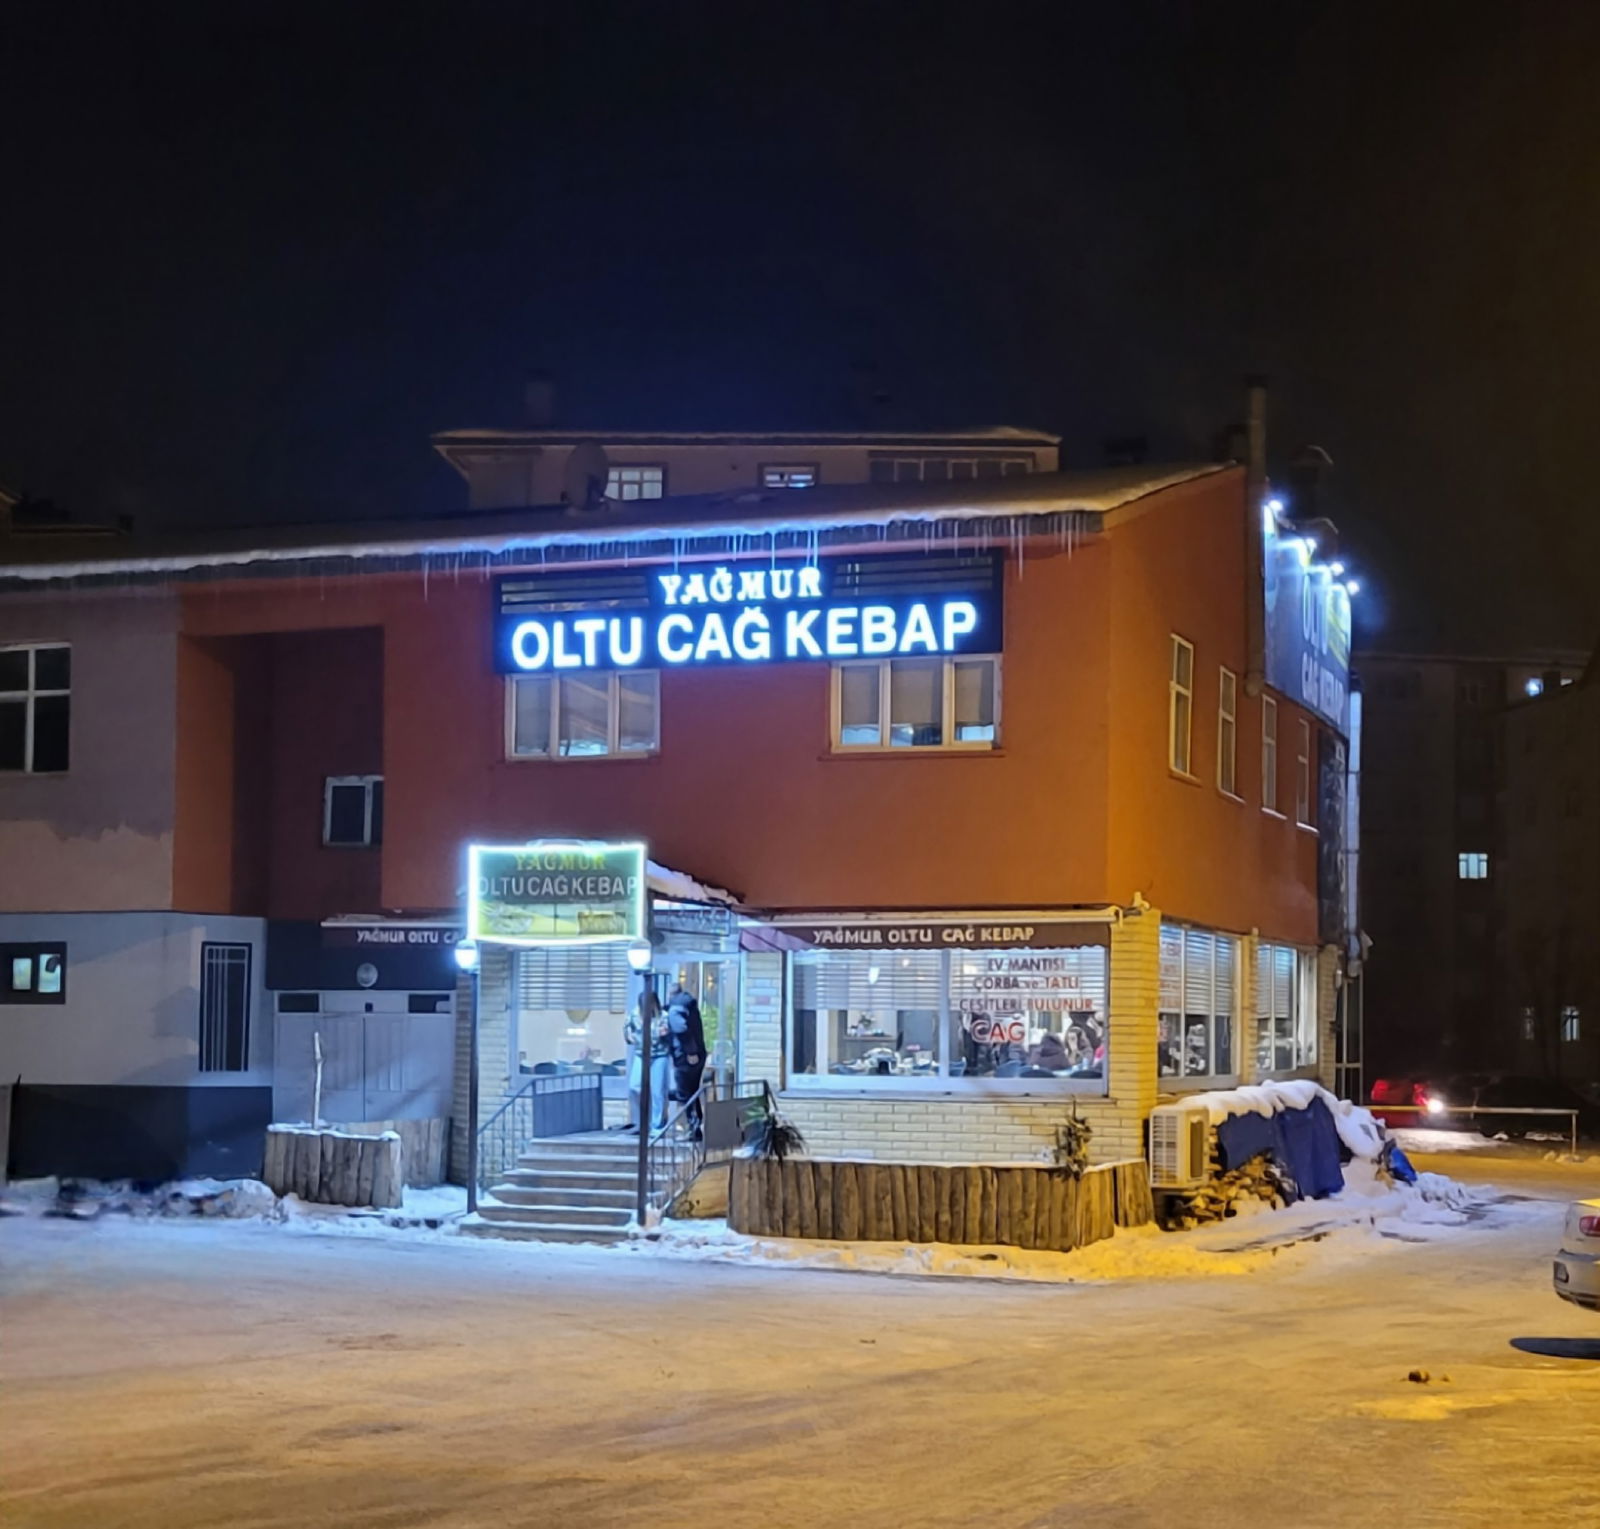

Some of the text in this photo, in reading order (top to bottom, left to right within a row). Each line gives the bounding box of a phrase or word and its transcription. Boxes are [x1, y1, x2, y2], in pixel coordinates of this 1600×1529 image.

[659, 567, 823, 605] YAĞMUR
[511, 602, 978, 670] OLTU CAĞ KEBAP
[477, 875, 639, 896] OLTU CAĞ KEBAP
[408, 930, 439, 943] OLTU
[813, 925, 1035, 944] YAĞMUR OLTU CAĞ KEBAP
[987, 958, 1004, 972] EV
[973, 976, 1020, 992] ÇORBA
[1046, 976, 1079, 989] TATLI
[1027, 998, 1093, 1012] BULUNUR
